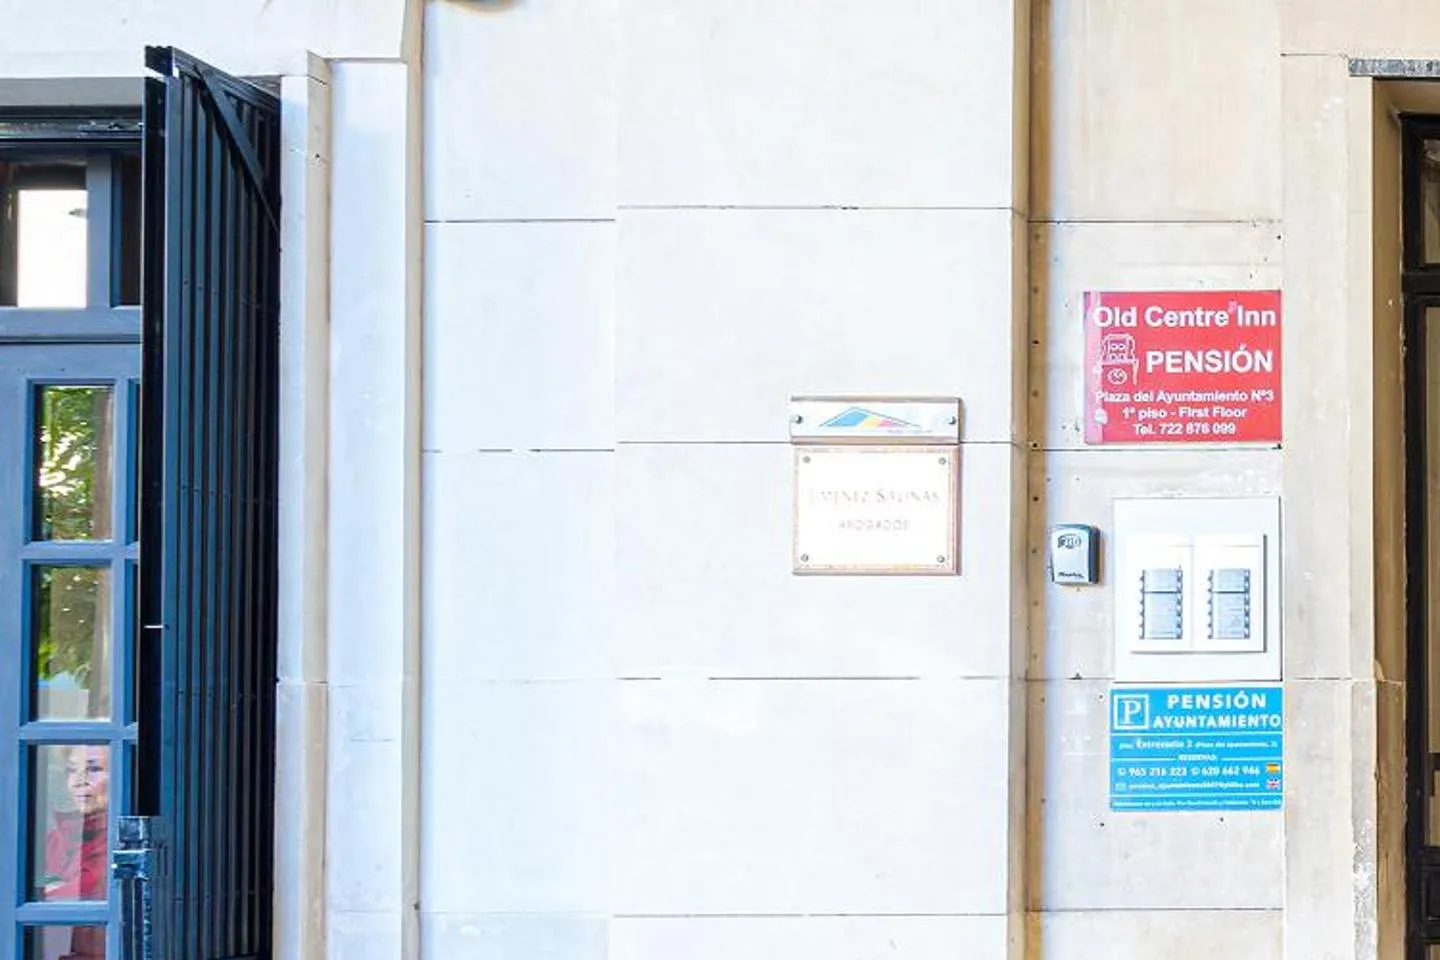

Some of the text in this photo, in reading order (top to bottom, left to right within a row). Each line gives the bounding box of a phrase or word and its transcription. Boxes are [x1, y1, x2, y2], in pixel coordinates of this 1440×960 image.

[1094, 304, 1276, 328] Old Centre Inn
[1146, 344, 1273, 374] PENSIÓN
[1096, 391, 1130, 403] Plaza
[1133, 391, 1153, 402] del
[1157, 390, 1248, 405] Ayuntamiento
[1138, 408, 1167, 421] piso
[1179, 406, 1210, 418] First
[1213, 406, 1247, 418] Floor
[1159, 423, 1182, 435] 722
[1167, 690, 1267, 710] PENSIÓN
[1153, 714, 1281, 729] AYUNTAMIENTO
